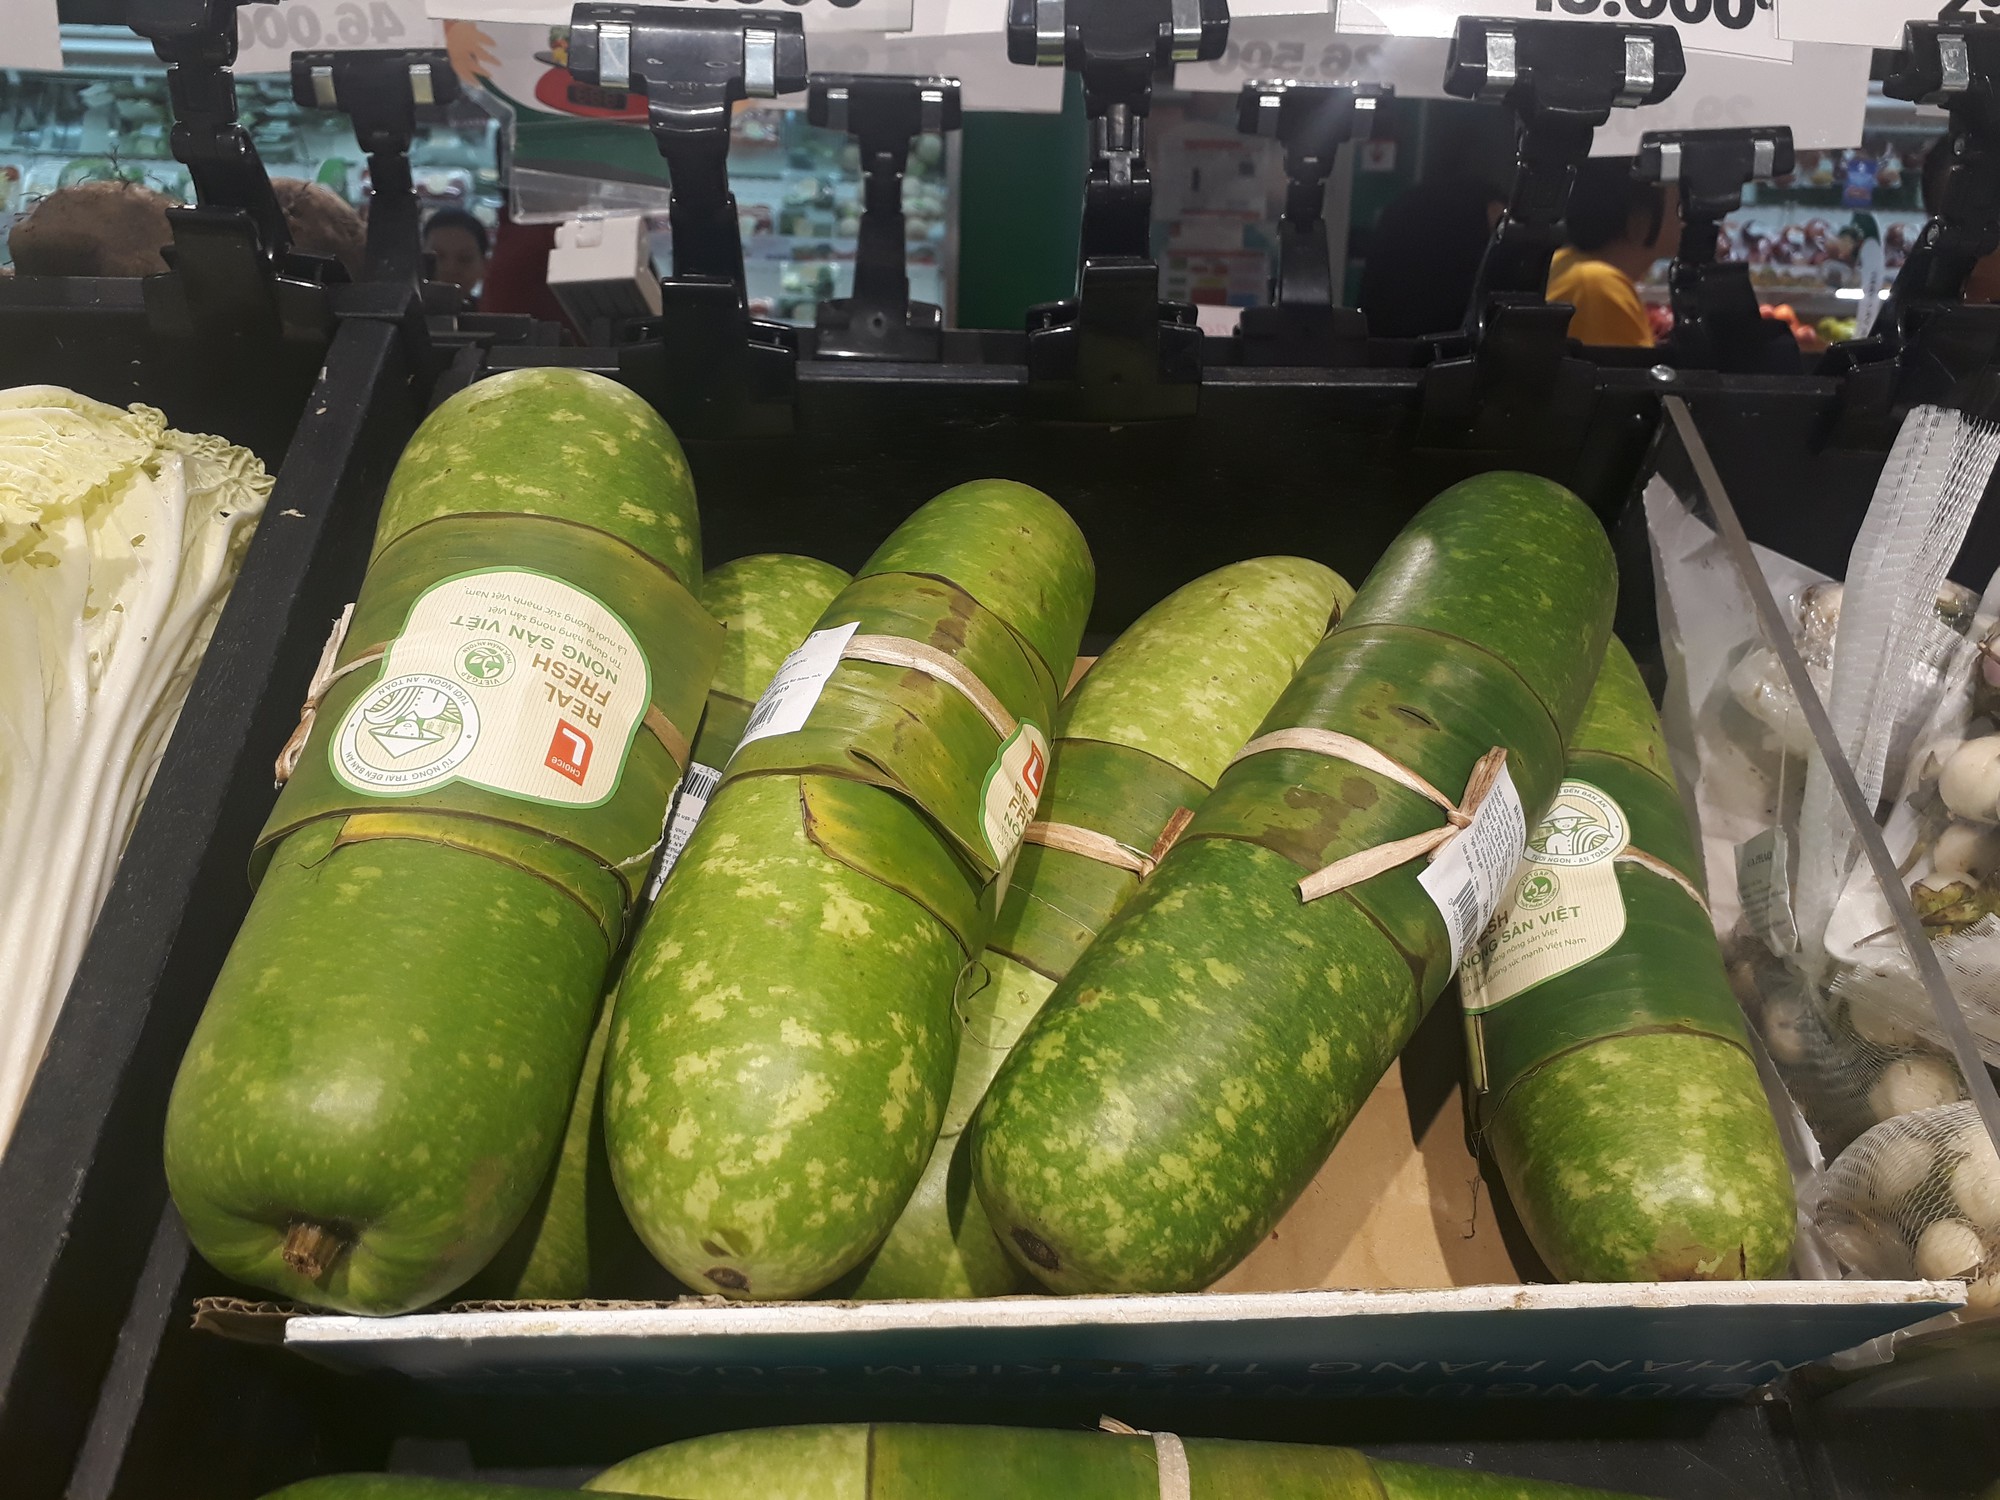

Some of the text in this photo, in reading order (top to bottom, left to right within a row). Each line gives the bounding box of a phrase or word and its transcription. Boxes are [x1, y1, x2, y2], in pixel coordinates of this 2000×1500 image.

[509, 609, 527, 623] sản
[529, 616, 556, 634] nông
[558, 626, 585, 644] hàng
[450, 614, 618, 685] NÔNG SẢN VIỆT
[405, 676, 420, 684] AN
[427, 677, 454, 692] NGON
[461, 671, 500, 686] VIETGAP
[531, 652, 612, 707] FRESH
[543, 681, 603, 729] REAL
[411, 765, 440, 779] NÔNG
[1015, 781, 1035, 819] REA
[1004, 811, 1021, 837] NÔ
[1460, 939, 1498, 971] NÔNG
[1501, 919, 1534, 943] SẢN
[1538, 905, 1581, 925] VIỆT
[1477, 910, 1509, 946] ESH
